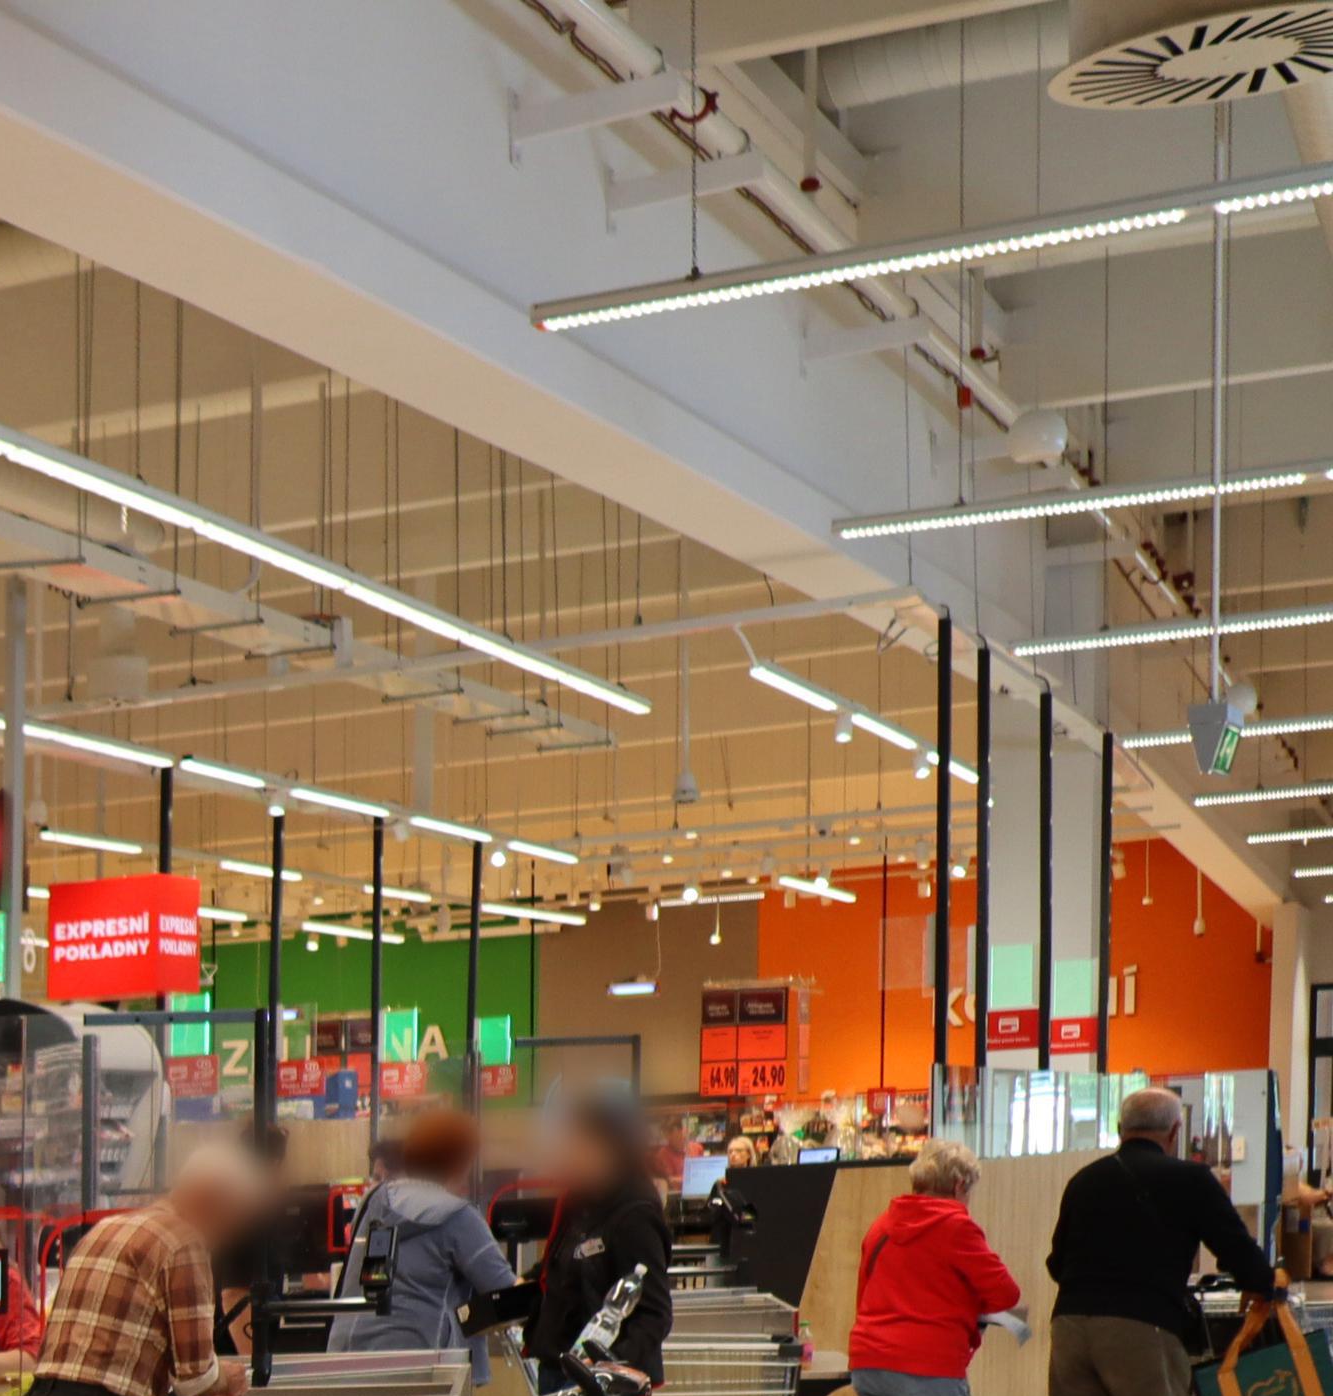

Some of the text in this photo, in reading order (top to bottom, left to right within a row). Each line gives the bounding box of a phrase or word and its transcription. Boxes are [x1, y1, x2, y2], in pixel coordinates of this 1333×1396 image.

[54, 912, 149, 941] EXPRESNÍ
[159, 914, 197, 936] EXPRESNÍ
[54, 940, 150, 963] POKLADNY
[159, 938, 197, 957] POKLADNY
[752, 1065, 784, 1087] 24.90
